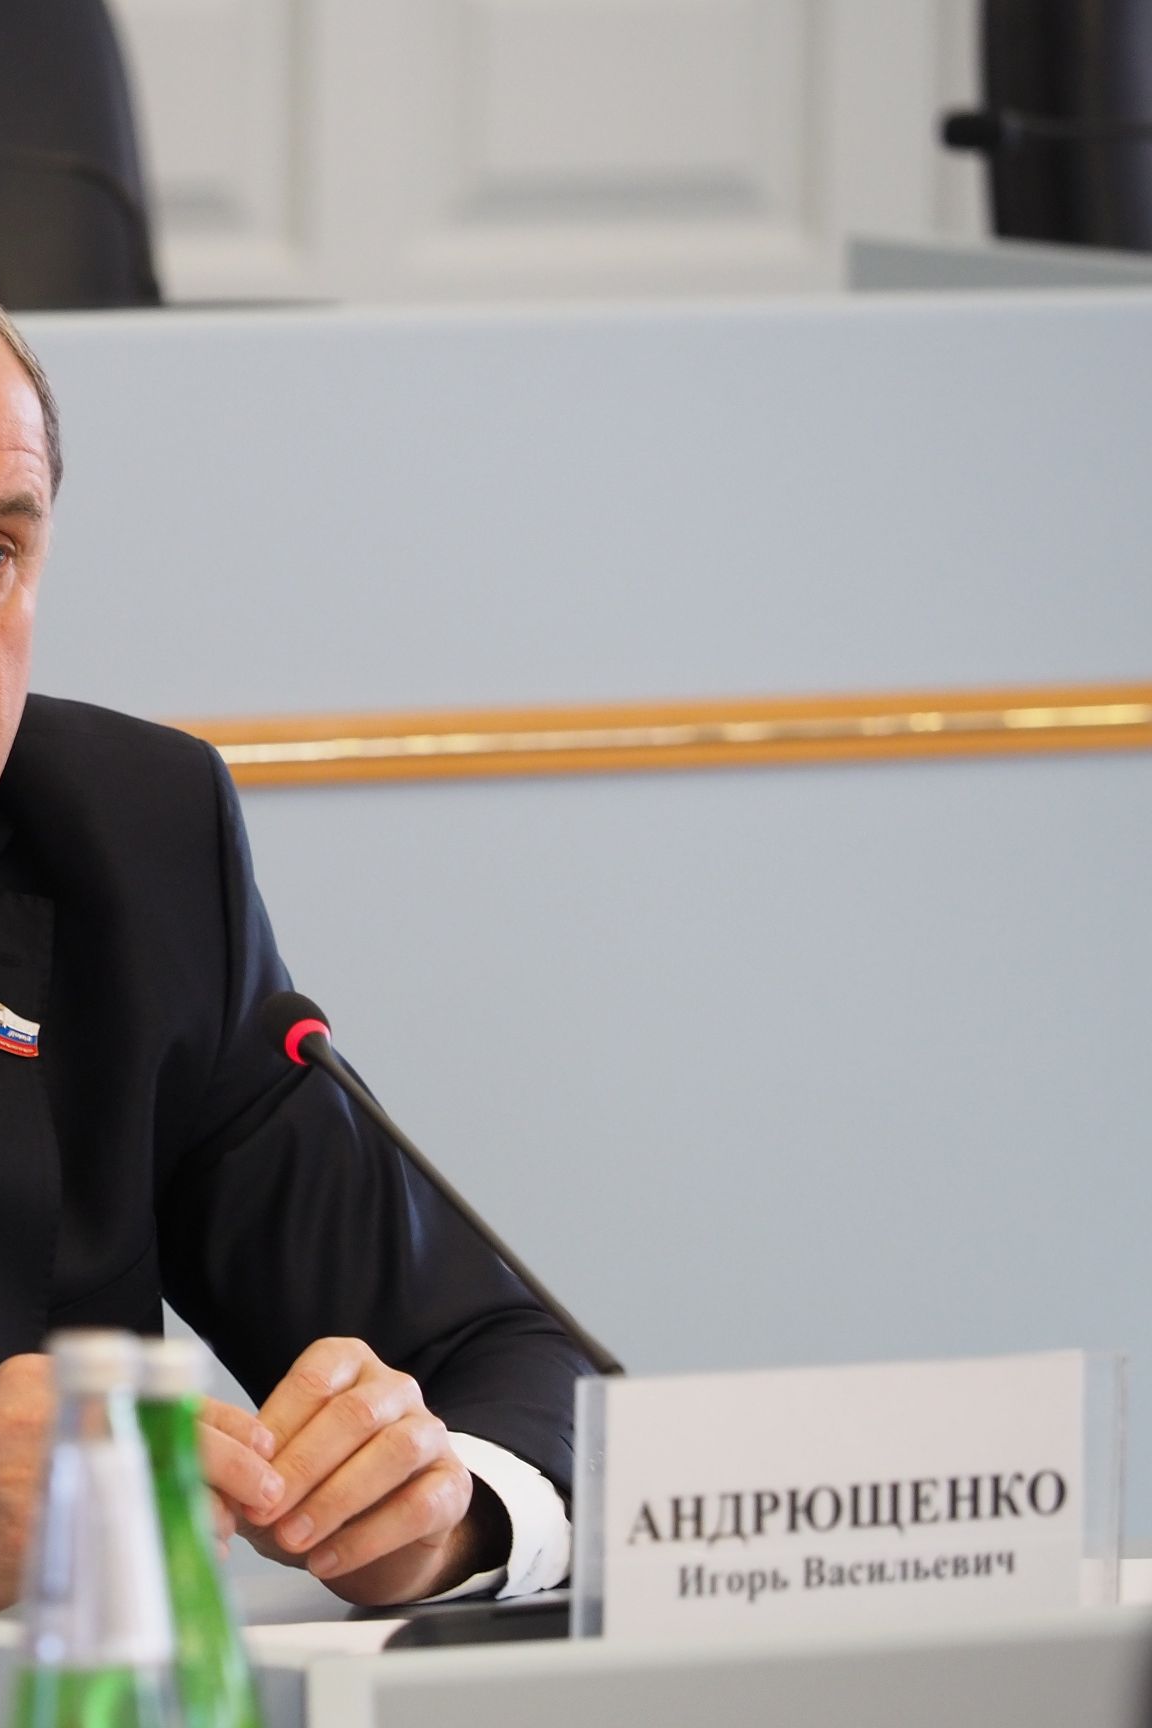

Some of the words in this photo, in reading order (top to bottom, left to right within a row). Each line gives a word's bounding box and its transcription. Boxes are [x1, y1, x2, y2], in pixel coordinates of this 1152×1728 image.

[627, 1468, 1069, 1547] АНДРЮЩЕНКО
[677, 1562, 790, 1602] Игорь
[802, 1550, 1017, 1590] Васильевич
